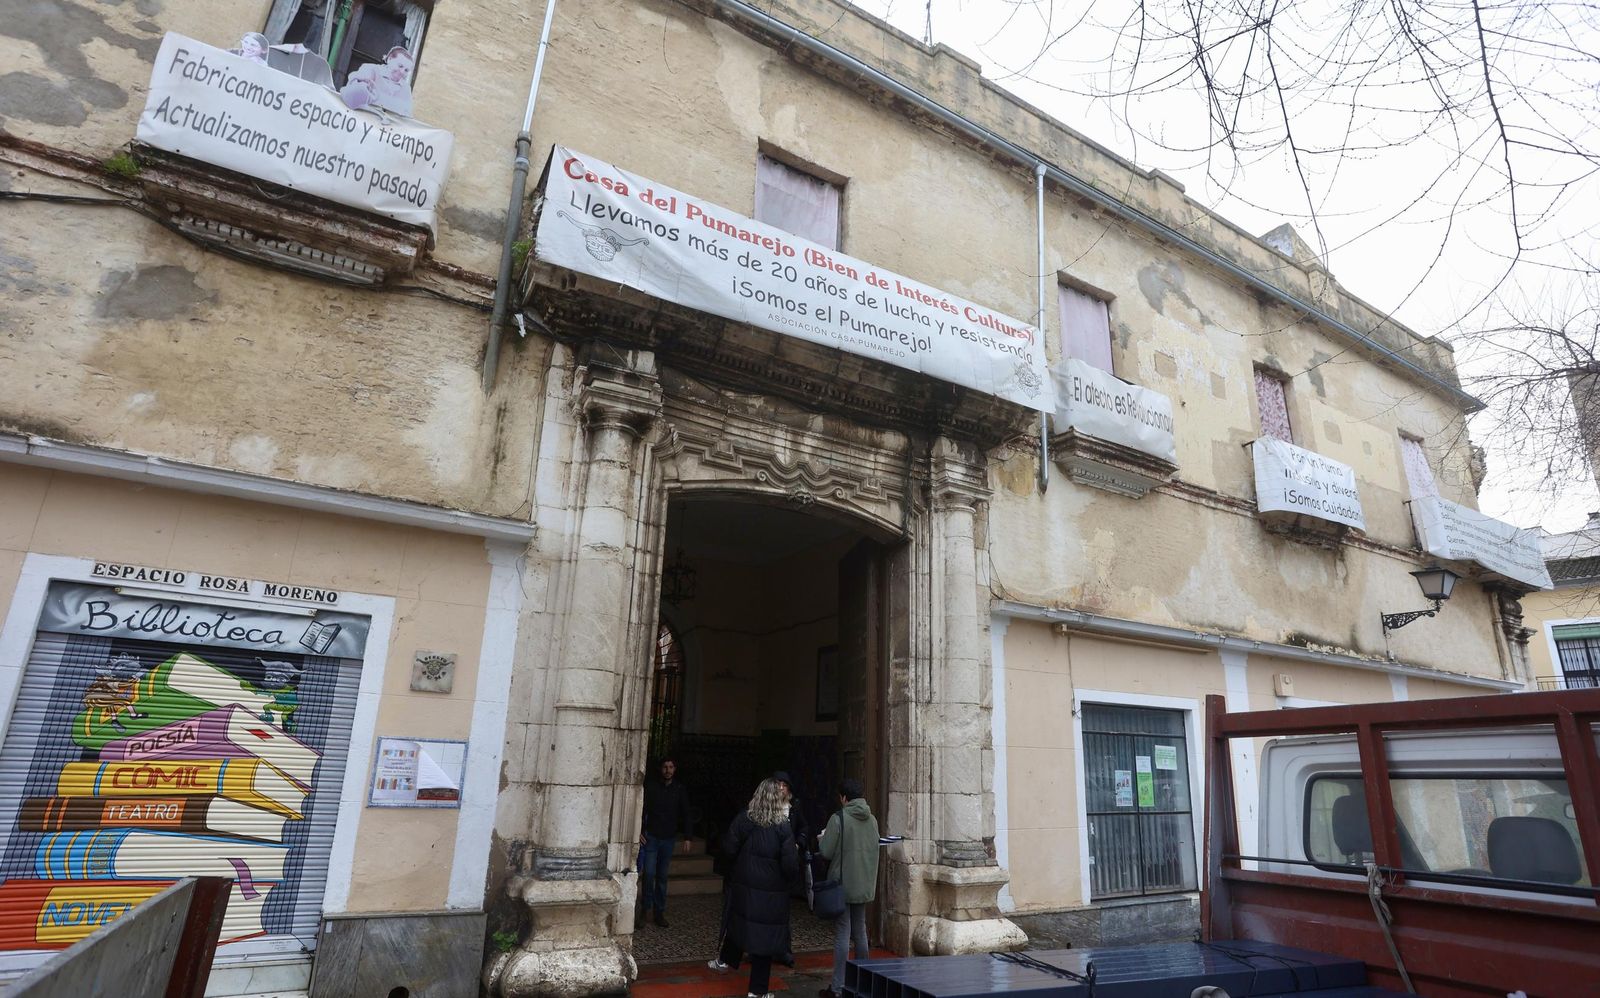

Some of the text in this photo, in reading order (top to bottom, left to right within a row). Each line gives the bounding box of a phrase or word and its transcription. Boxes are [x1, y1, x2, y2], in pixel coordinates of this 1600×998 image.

[169, 48, 437, 168] Fabricamos espacio y tiempo,
[153, 96, 428, 208] Actualizamos nuestro pasado
[563, 157, 629, 196] Casa
[638, 188, 676, 214] del
[686, 202, 796, 258] Pumarejo
[804, 248, 859, 281] (Bien
[865, 272, 890, 290] de
[896, 279, 959, 315] Interés
[570, 190, 1033, 365] Llevamos más de 20 años de lucha y resistencia
[732, 276, 932, 353] ¡Somos el Pumarejo!
[830, 332, 855, 343] CASA
[858, 340, 906, 358] PUMAREJO
[1074, 377, 1082, 402] El
[1115, 394, 1127, 415] es
[1284, 488, 1320, 510] ¡Somos
[1322, 480, 1329, 495] y
[92, 562, 338, 603] ESPACIO ROSA MORENO
[80, 600, 286, 645] Biblioteca
[129, 724, 195, 756] POESÍA
[112, 763, 210, 789] CÓMIC
[108, 804, 179, 820] TEATRO
